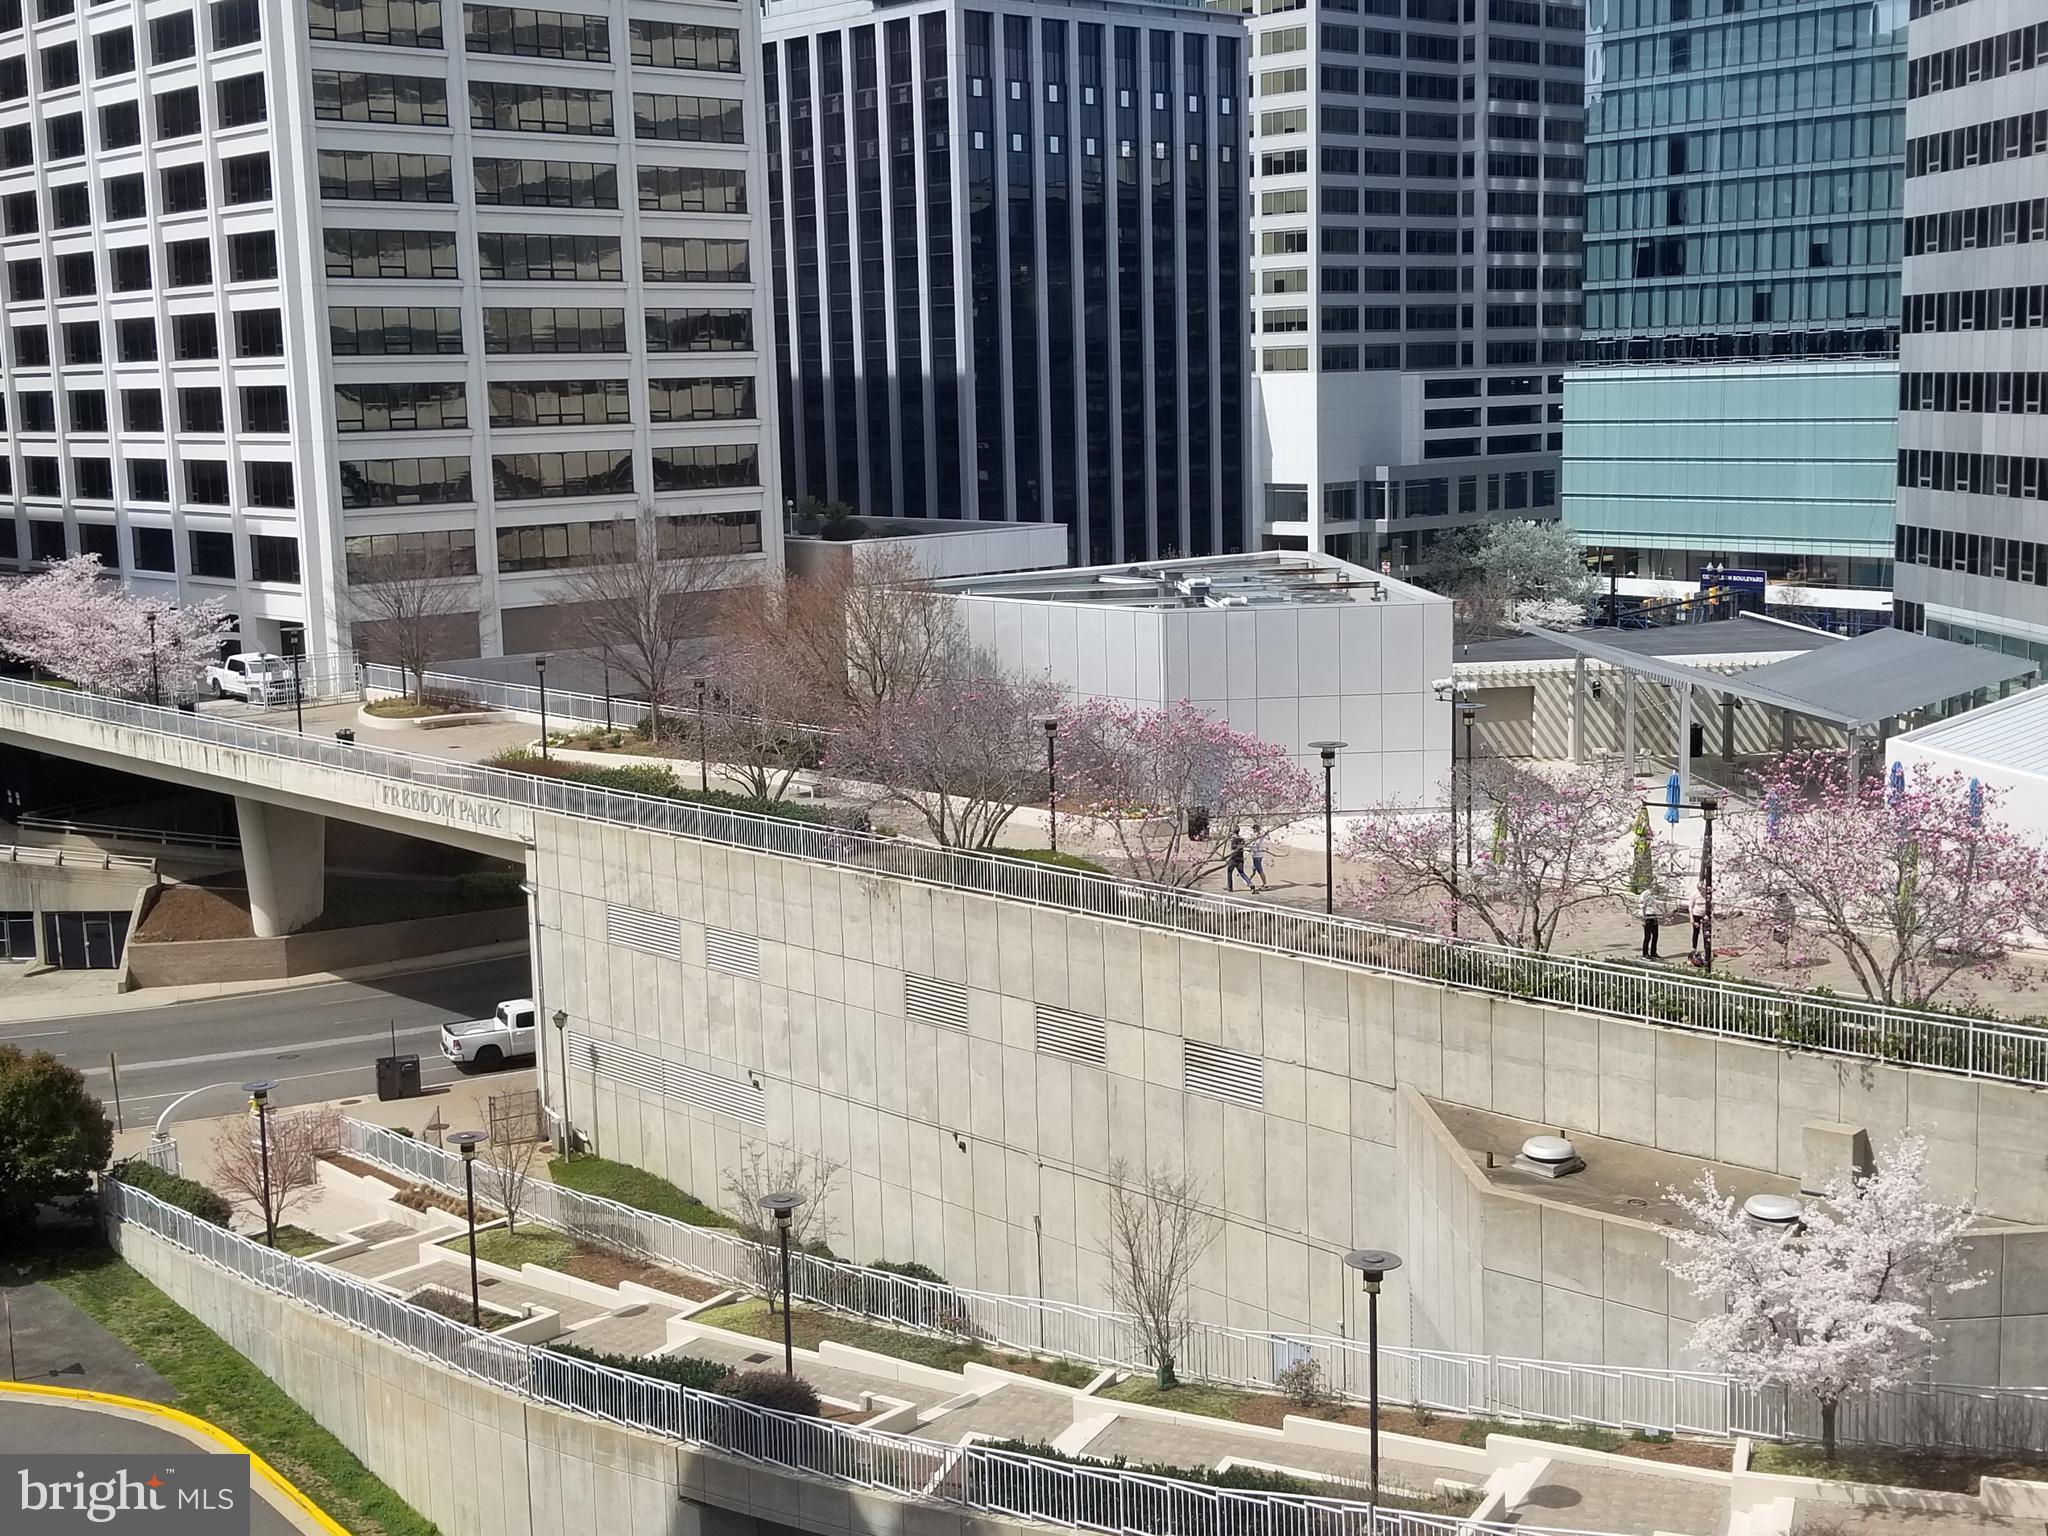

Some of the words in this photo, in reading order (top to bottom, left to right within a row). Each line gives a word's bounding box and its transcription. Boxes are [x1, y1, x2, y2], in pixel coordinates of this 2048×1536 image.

[1733, 575, 1764, 583] BOULEVARD
[382, 784, 456, 819] FREEDOM
[459, 799, 502, 829] PARK
